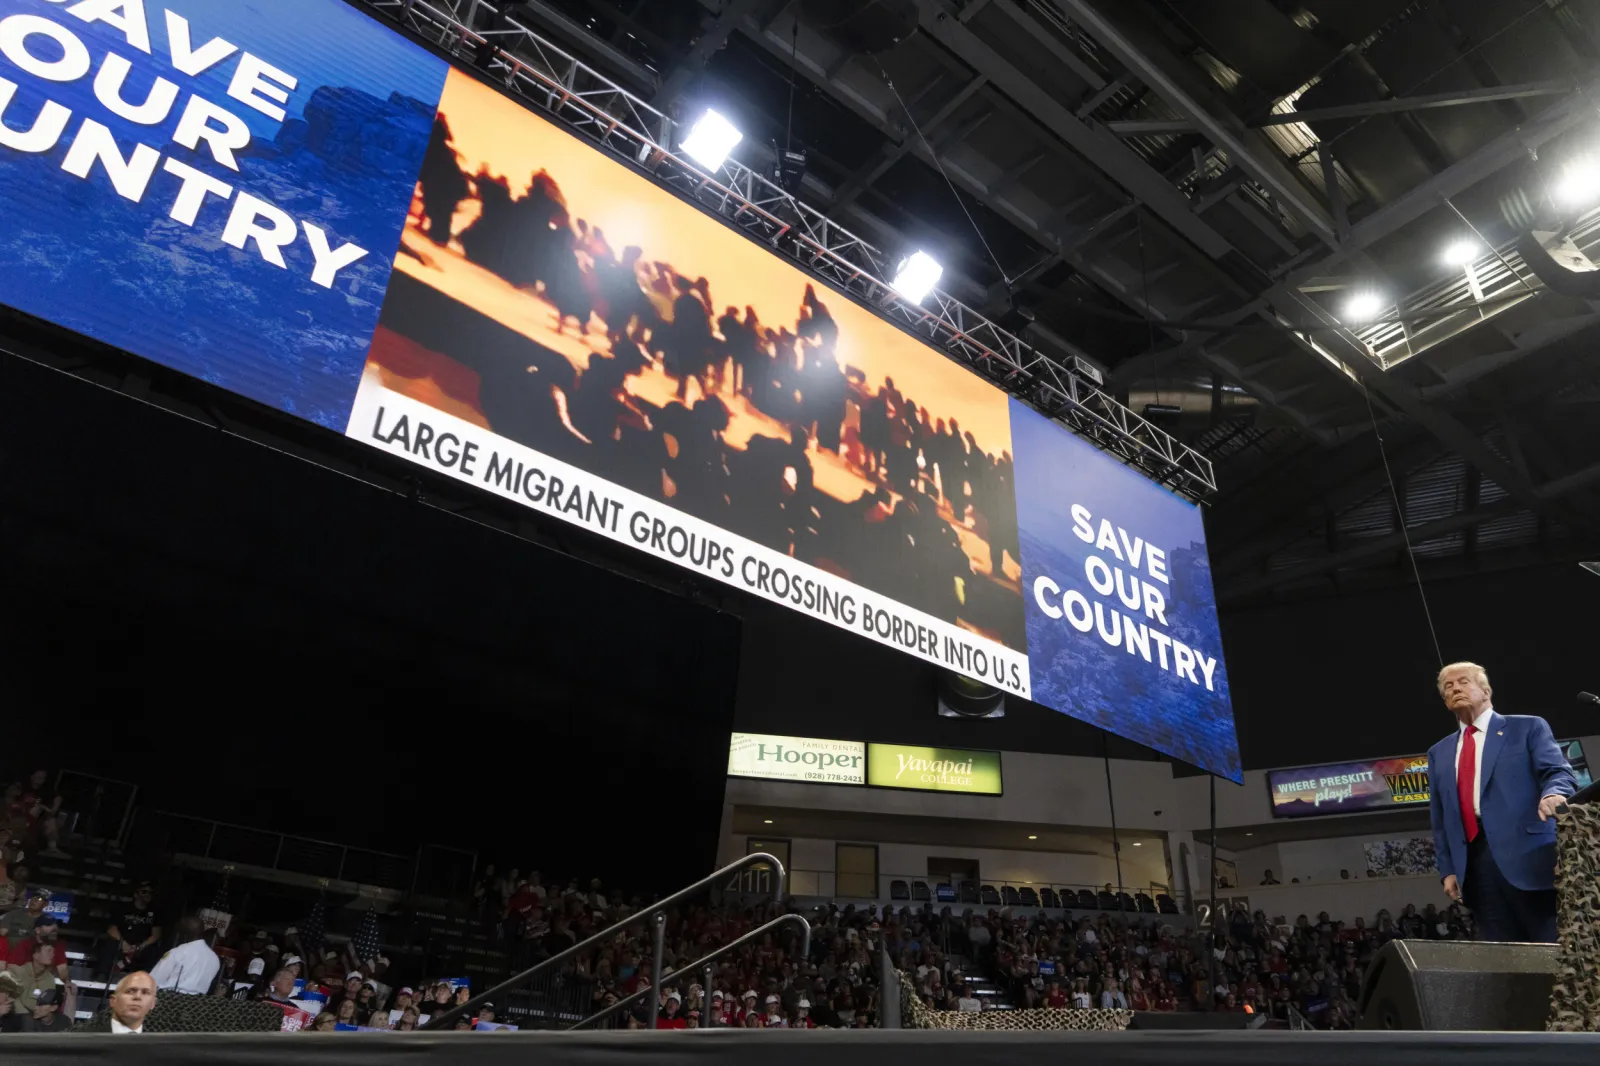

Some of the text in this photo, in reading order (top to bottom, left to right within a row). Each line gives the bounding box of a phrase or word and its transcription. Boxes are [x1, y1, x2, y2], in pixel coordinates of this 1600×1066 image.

[44, 0, 298, 122] AVE
[0, 14, 251, 172] OUR
[0, 76, 370, 289] UNTRY
[371, 406, 1026, 693] LARGE MIGRANT GROUPS CROSSING BORDER INTO U.S.
[1070, 503, 1170, 585] SAVE
[1084, 555, 1169, 627] OUR
[1033, 575, 1217, 692] COUNTRY
[757, 743, 863, 770] Hooper
[802, 741, 862, 753] FAMILY DENTAL
[804, 771, 863, 783] (928) 778-2421
[895, 753, 973, 780] Yavapai
[920, 773, 973, 786] COLLEGE
[1277, 770, 1374, 794] WHERE PRESKITT
[1314, 784, 1353, 807] plays!
[1383, 772, 1430, 796] YAVA
[1393, 793, 1431, 803] CASI
